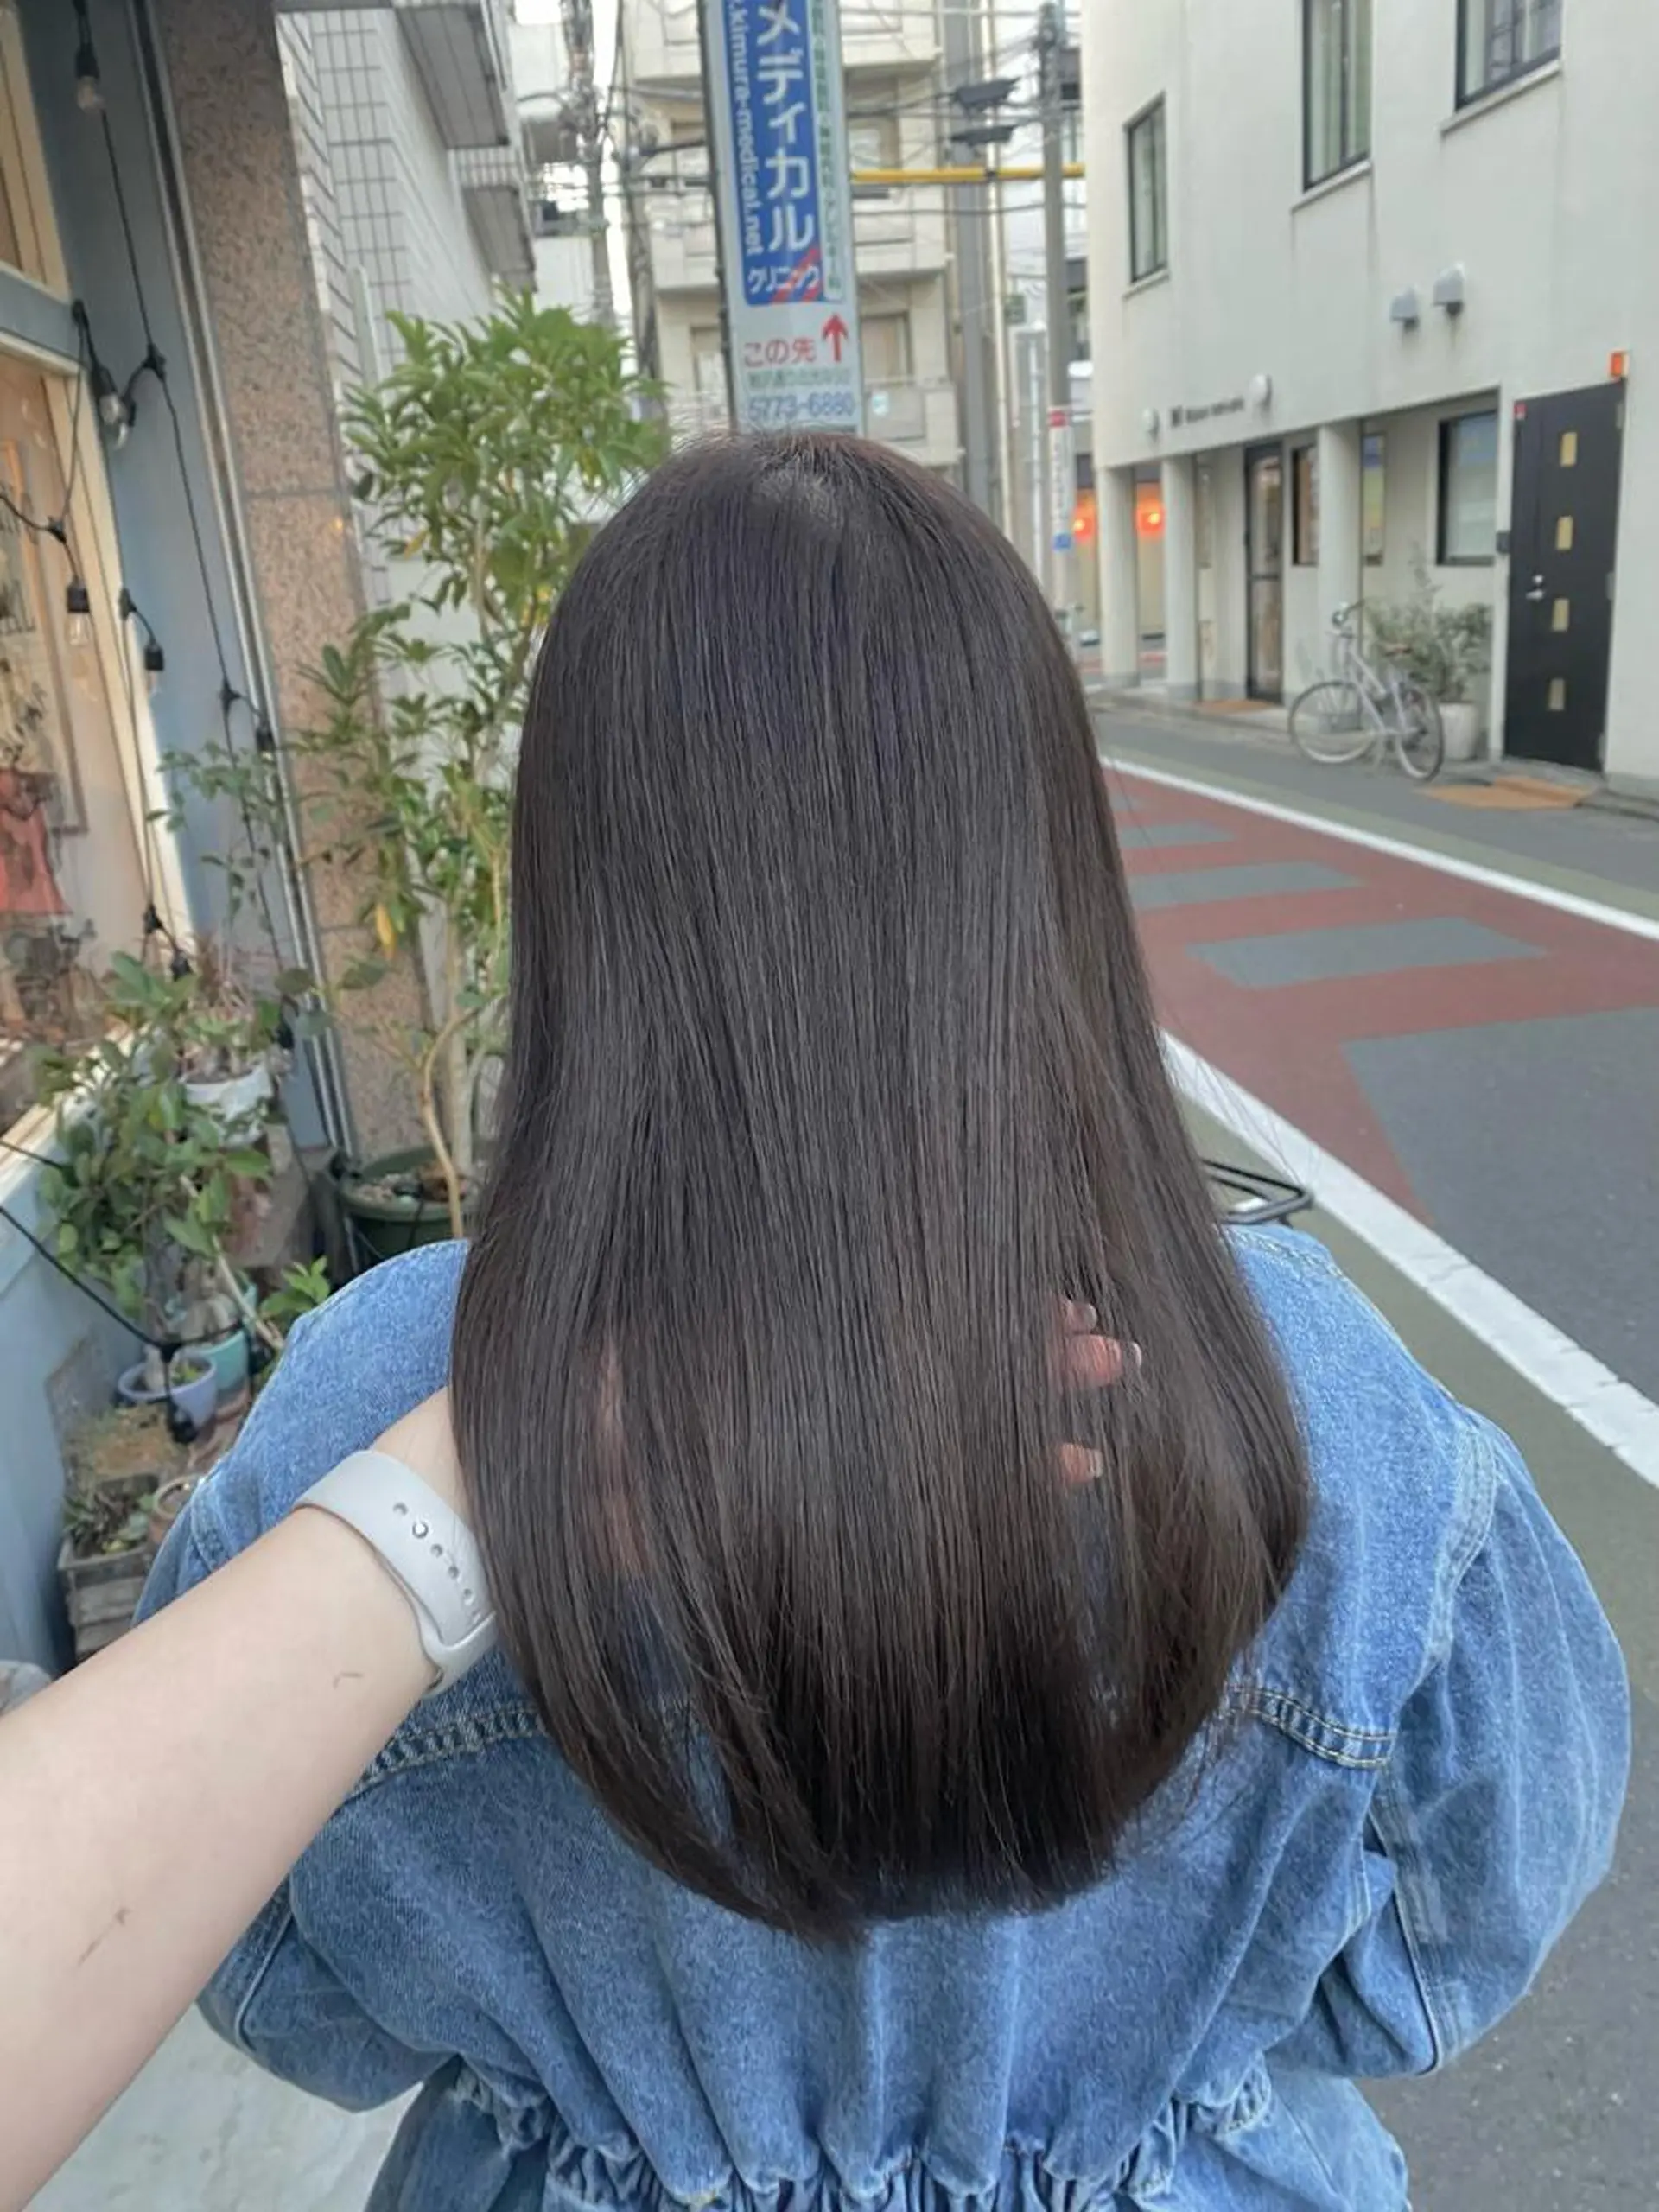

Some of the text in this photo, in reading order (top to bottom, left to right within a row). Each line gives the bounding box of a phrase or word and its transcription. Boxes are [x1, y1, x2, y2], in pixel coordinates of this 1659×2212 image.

[757, 0, 814, 253] メディカル
[748, 264, 820, 295] クリニック
[744, 336, 817, 368] この先
